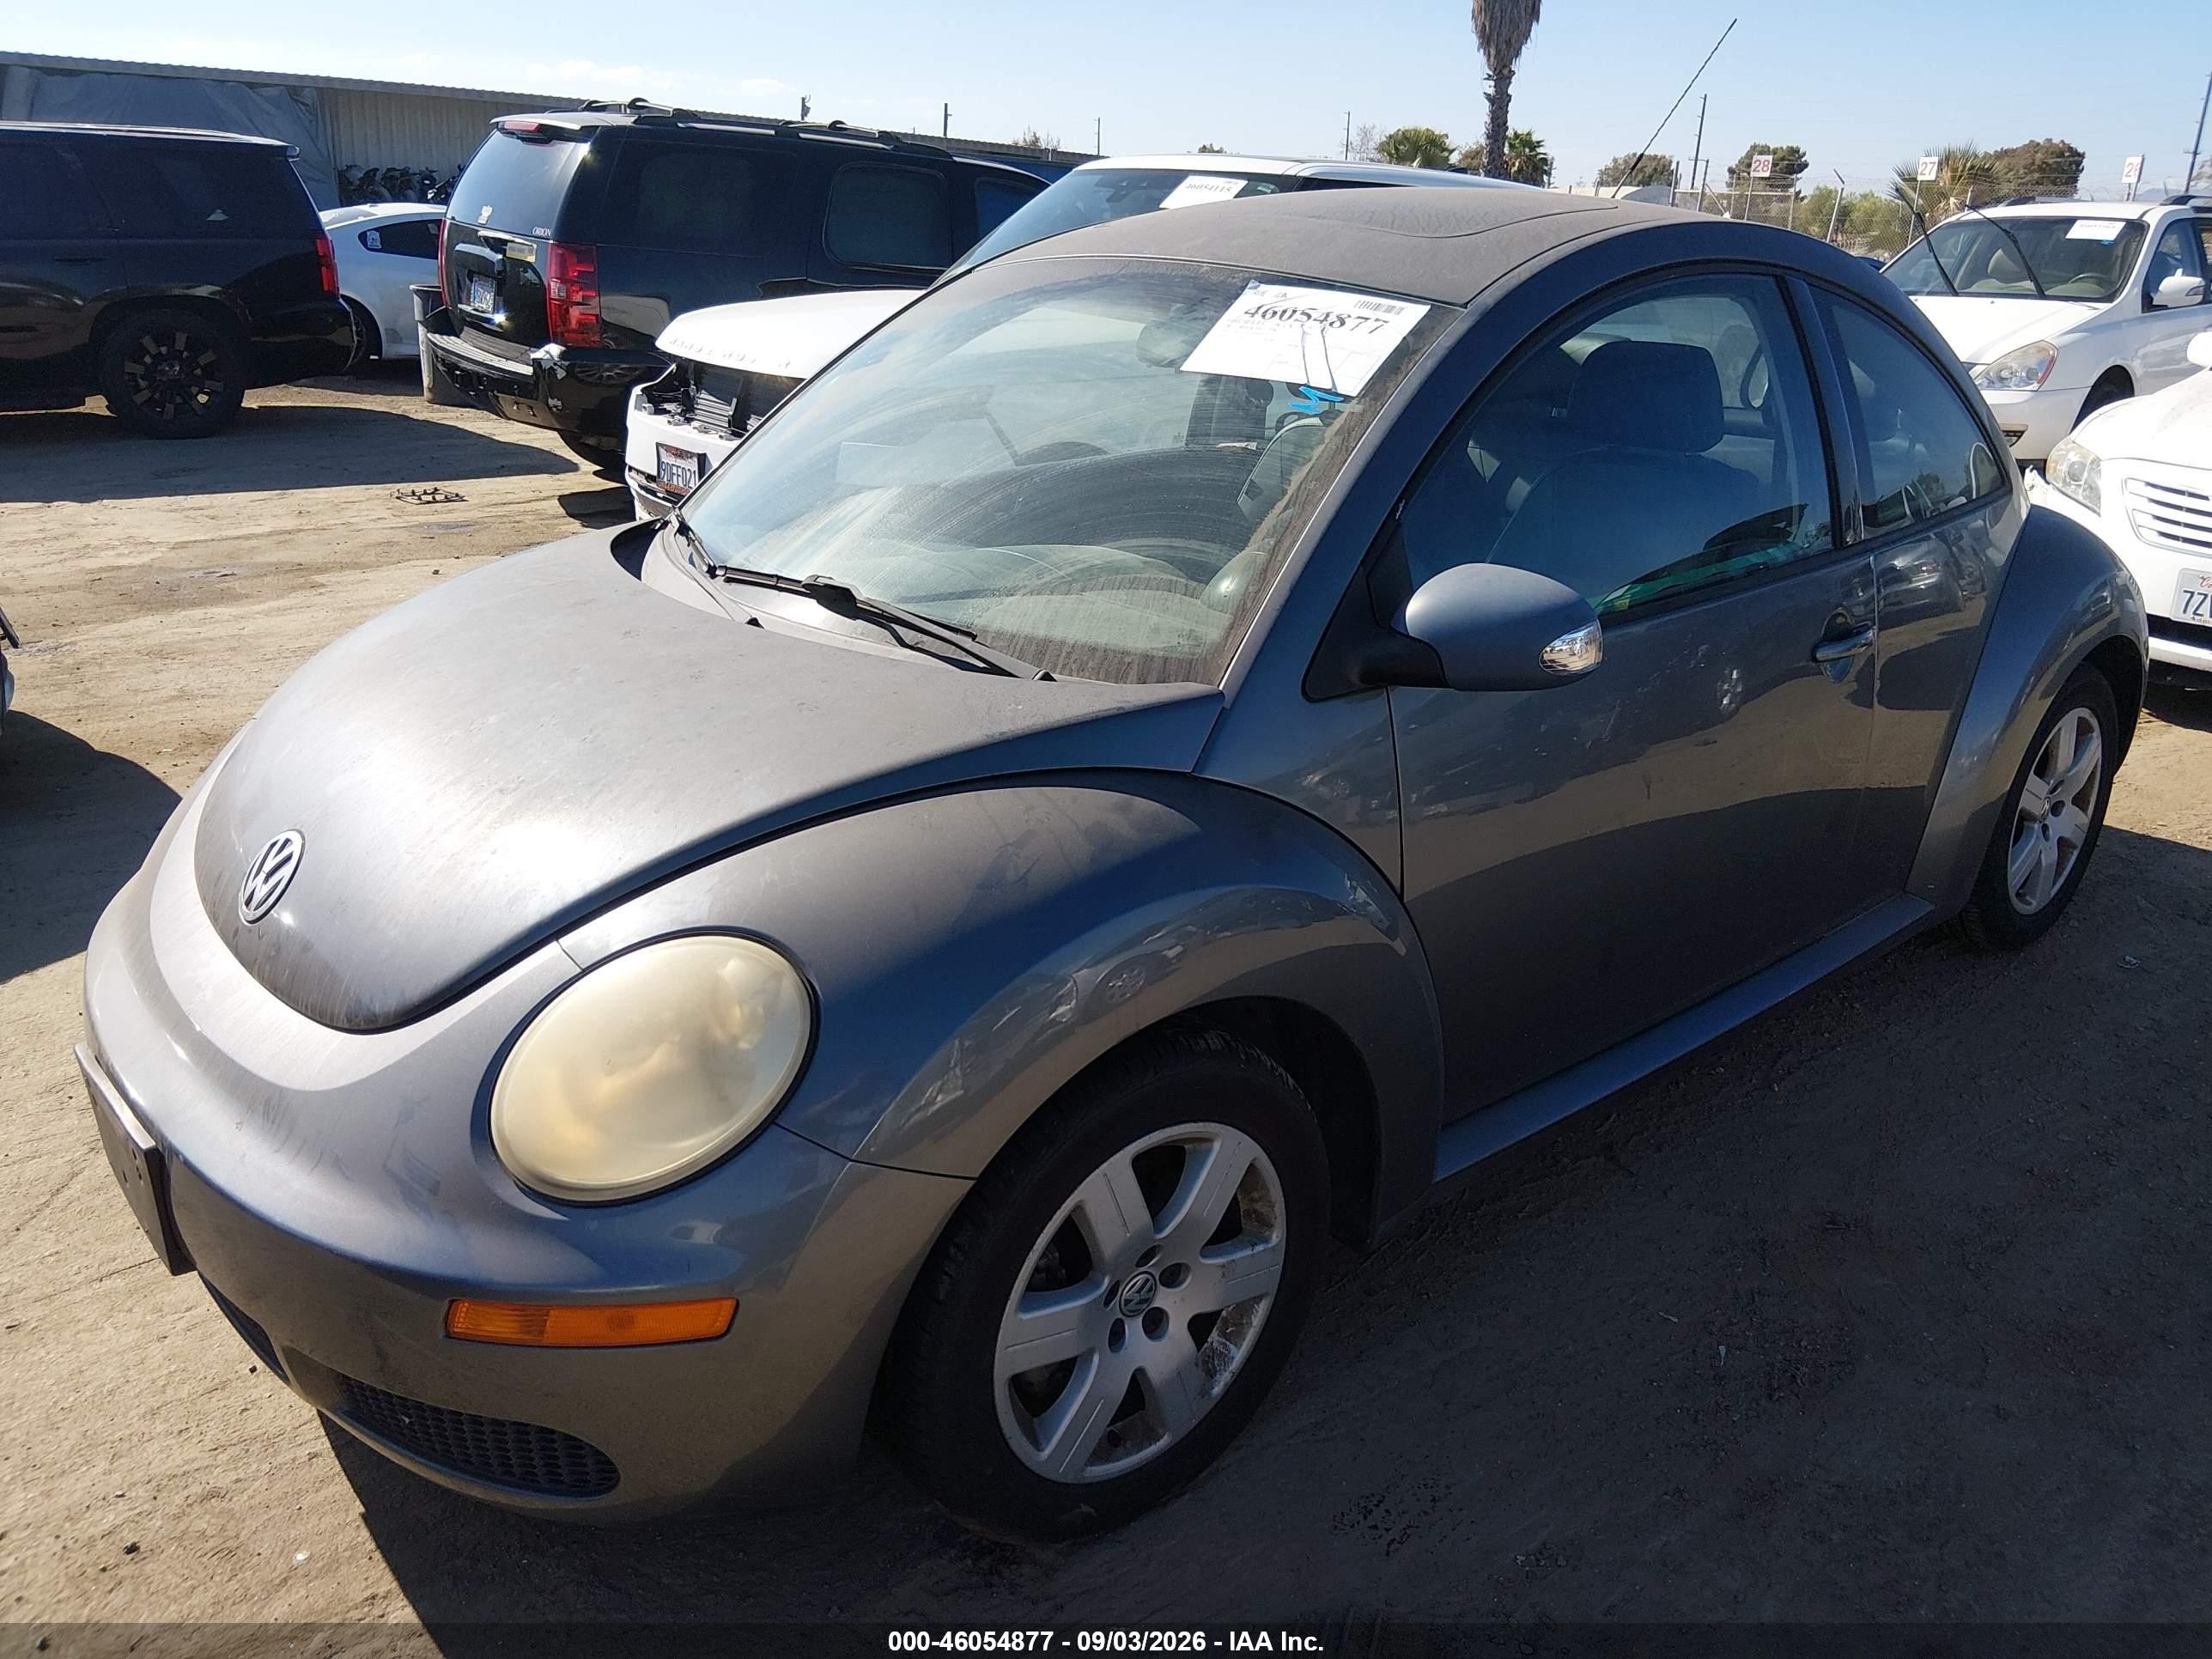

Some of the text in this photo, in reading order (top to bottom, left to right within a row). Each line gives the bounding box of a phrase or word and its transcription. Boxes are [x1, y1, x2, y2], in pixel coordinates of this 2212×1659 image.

[1753, 159, 1771, 173] 28
[1918, 161, 1937, 176] 27
[1243, 301, 1389, 335] 46054877
